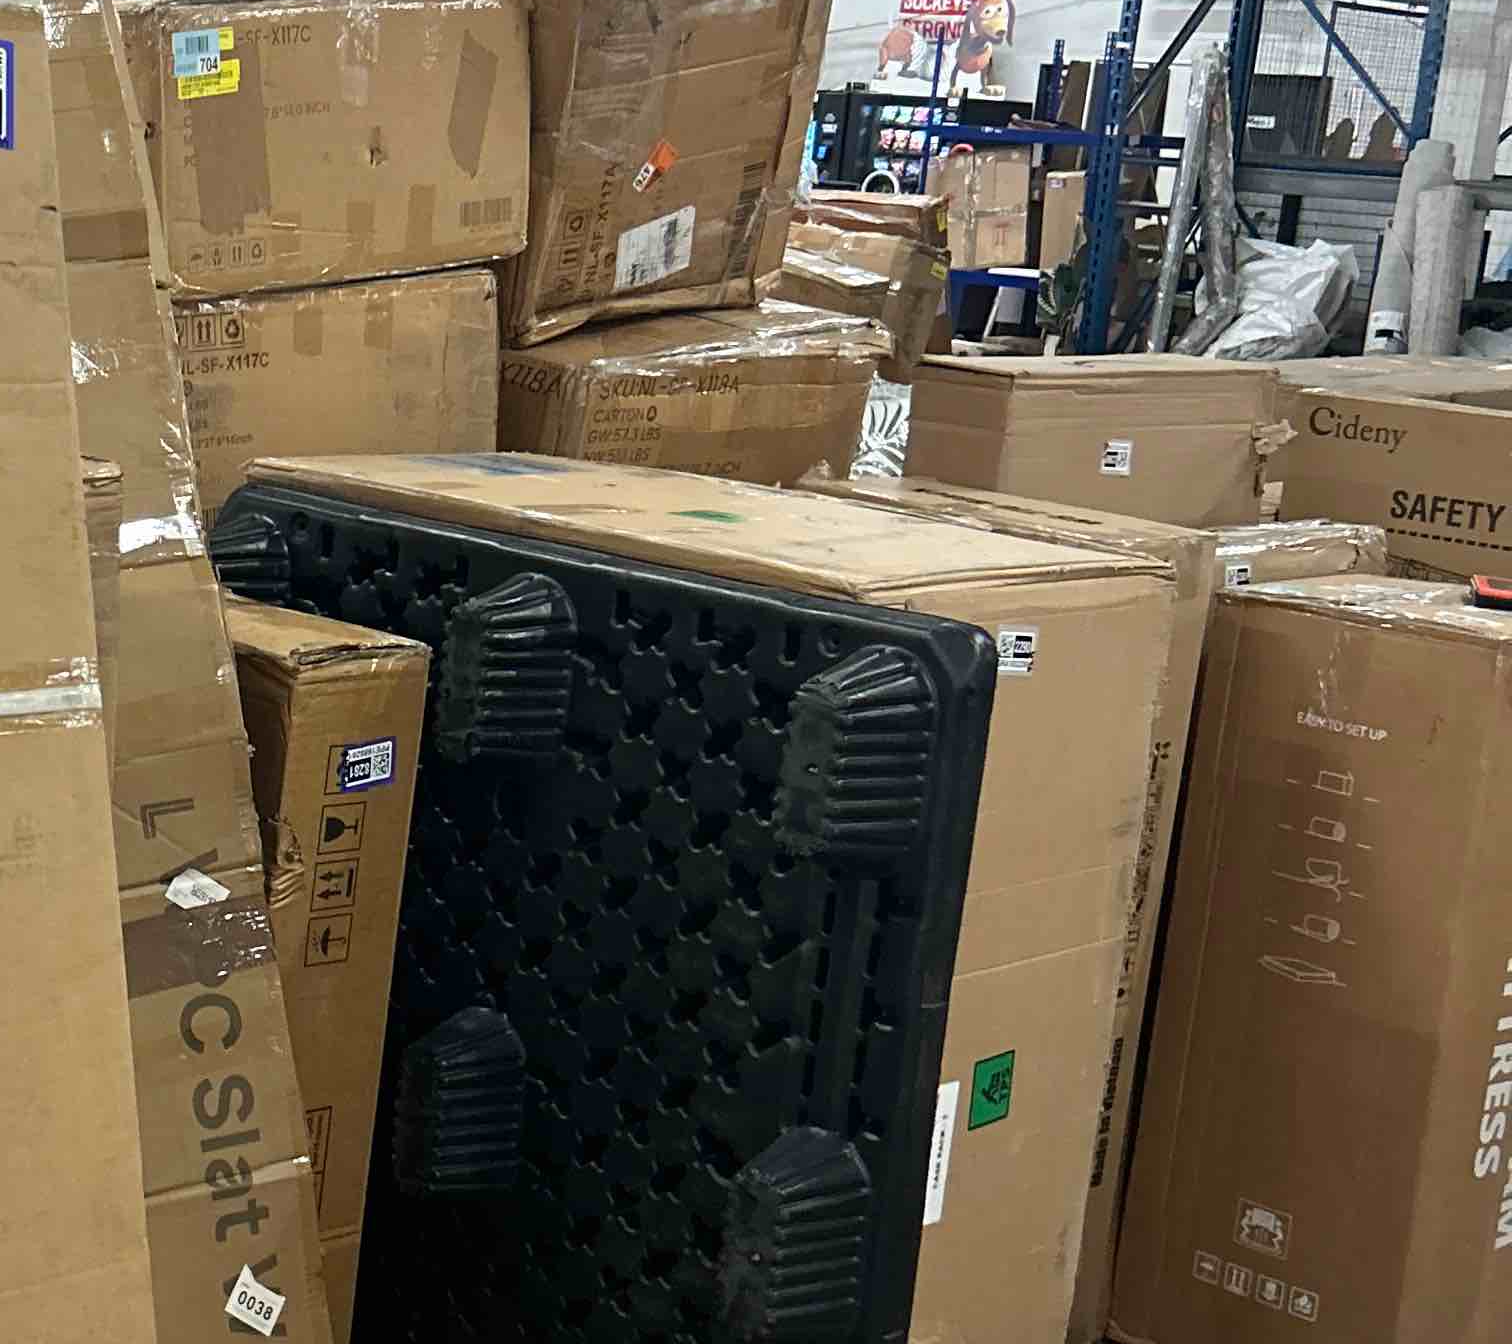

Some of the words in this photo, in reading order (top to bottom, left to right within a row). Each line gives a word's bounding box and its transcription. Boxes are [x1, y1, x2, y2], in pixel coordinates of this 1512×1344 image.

[199, 57, 219, 72] 704
[1309, 406, 1407, 453] Cideny
[1390, 489, 1507, 533] SAFETY
[1326, 716, 1345, 733] TO
[1345, 719, 1369, 737] SET
[1368, 724, 1387, 741] UP
[192, 1072, 270, 1243] Slat
[237, 1289, 275, 1321] 0038
